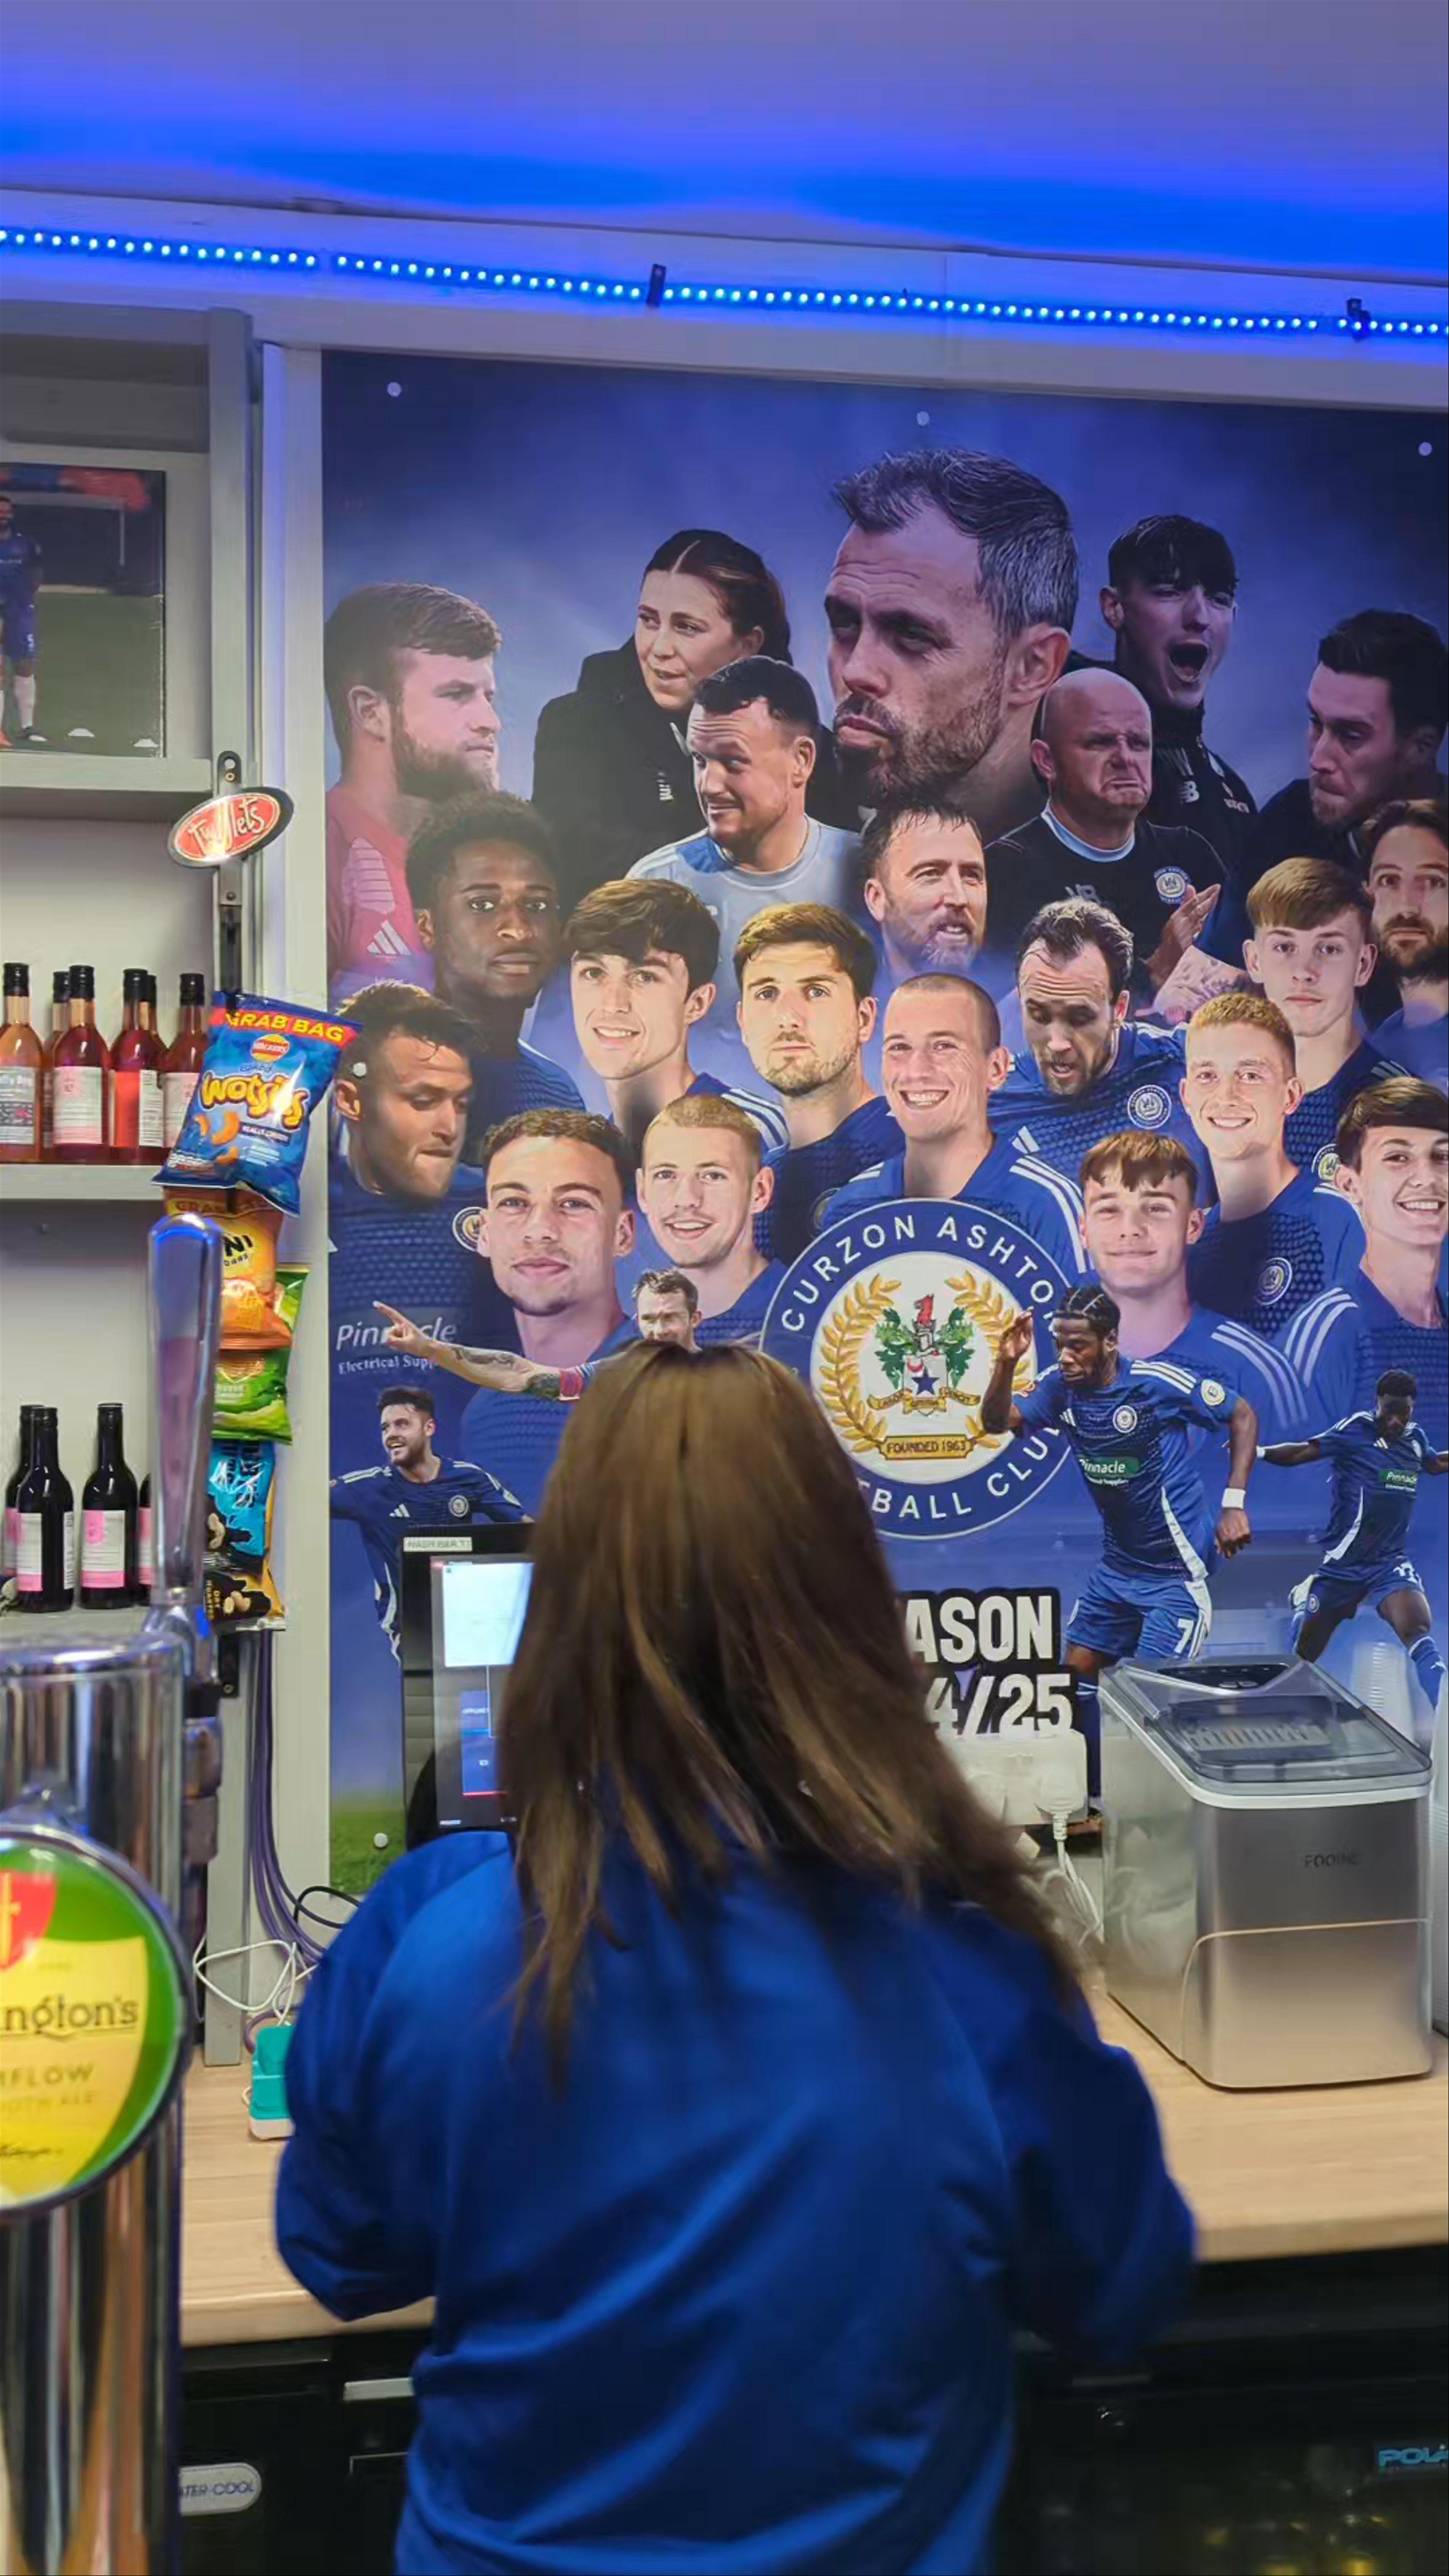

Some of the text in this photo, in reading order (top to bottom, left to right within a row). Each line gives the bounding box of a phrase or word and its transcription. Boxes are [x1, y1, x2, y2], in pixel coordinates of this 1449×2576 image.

[226, 1011, 343, 1042] GRAB BAG
[221, 1235, 254, 1257] NI
[781, 1214, 1058, 1336] CURZON ASHTO
[336, 1317, 456, 1351] Pinncle
[338, 1356, 399, 1375] Electrical
[887, 1439, 966, 1454] FOUNDED 1963
[857, 1427, 1060, 1519] BALL CLU
[905, 1595, 1053, 1664] ASON
[1174, 1617, 1194, 1654] 7
[924, 1673, 1073, 1736] 4/25
[5, 1994, 139, 2035] ngton's
[0, 2062, 94, 2088] FLOW
